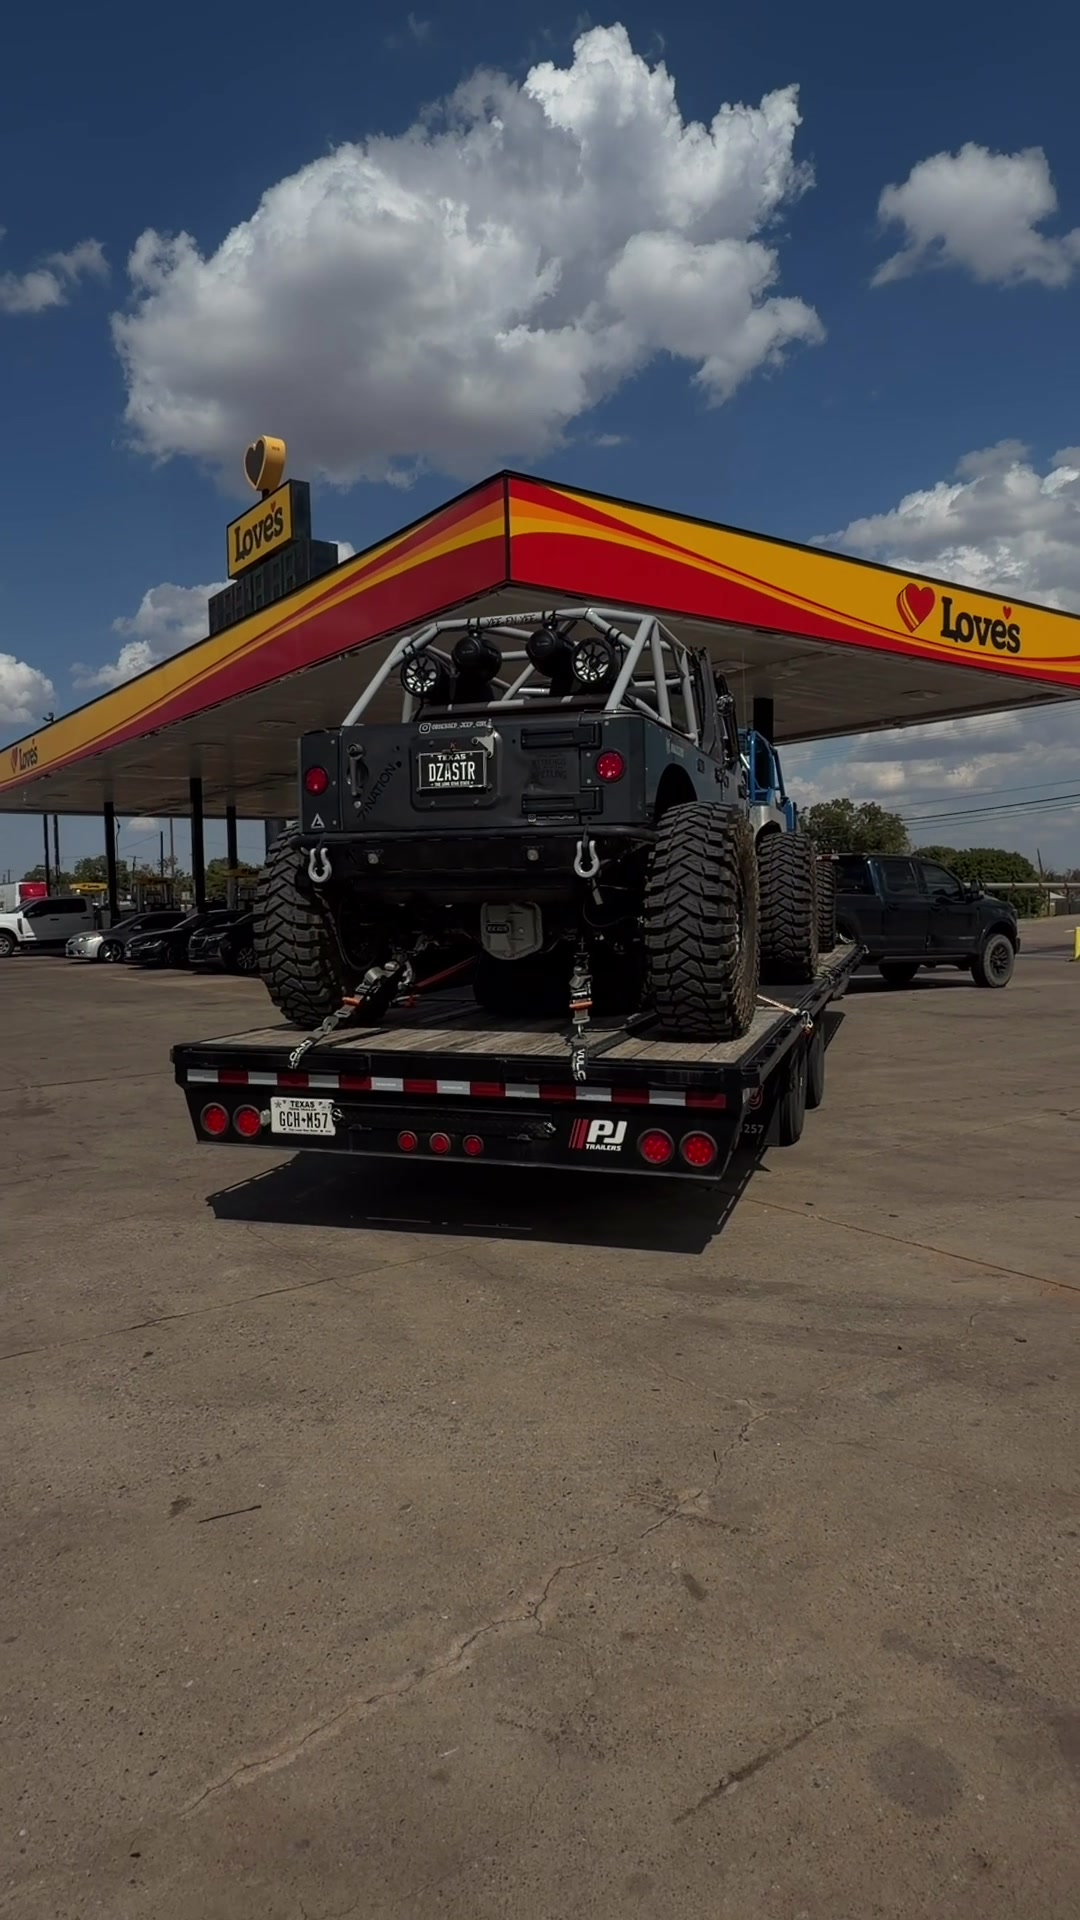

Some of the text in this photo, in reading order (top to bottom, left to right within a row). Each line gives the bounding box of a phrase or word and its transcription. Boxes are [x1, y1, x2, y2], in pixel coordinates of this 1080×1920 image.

[234, 501, 284, 563] Love's
[940, 596, 1021, 654] Love's
[437, 753, 467, 761] TEXAS
[428, 761, 475, 782] DZASTR
[290, 1100, 315, 1108] TEXAS
[586, 1119, 628, 1144] PJ
[586, 1143, 622, 1152] TRAILERS
